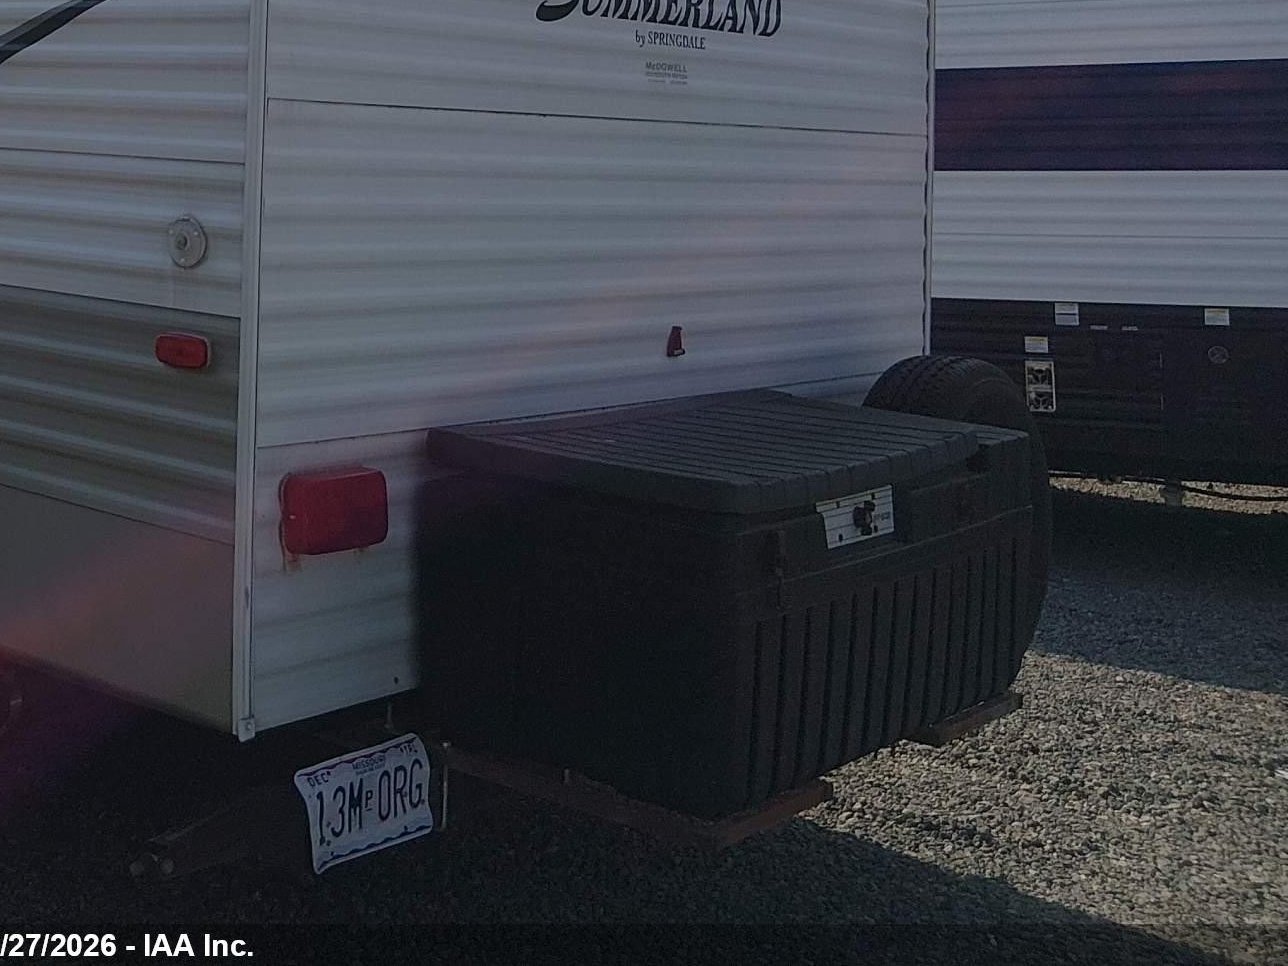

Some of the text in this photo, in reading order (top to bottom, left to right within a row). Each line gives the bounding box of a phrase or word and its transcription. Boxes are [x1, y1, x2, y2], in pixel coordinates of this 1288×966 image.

[635, 29, 706, 50] by SPRINGDALE
[306, 773, 329, 787] DEC
